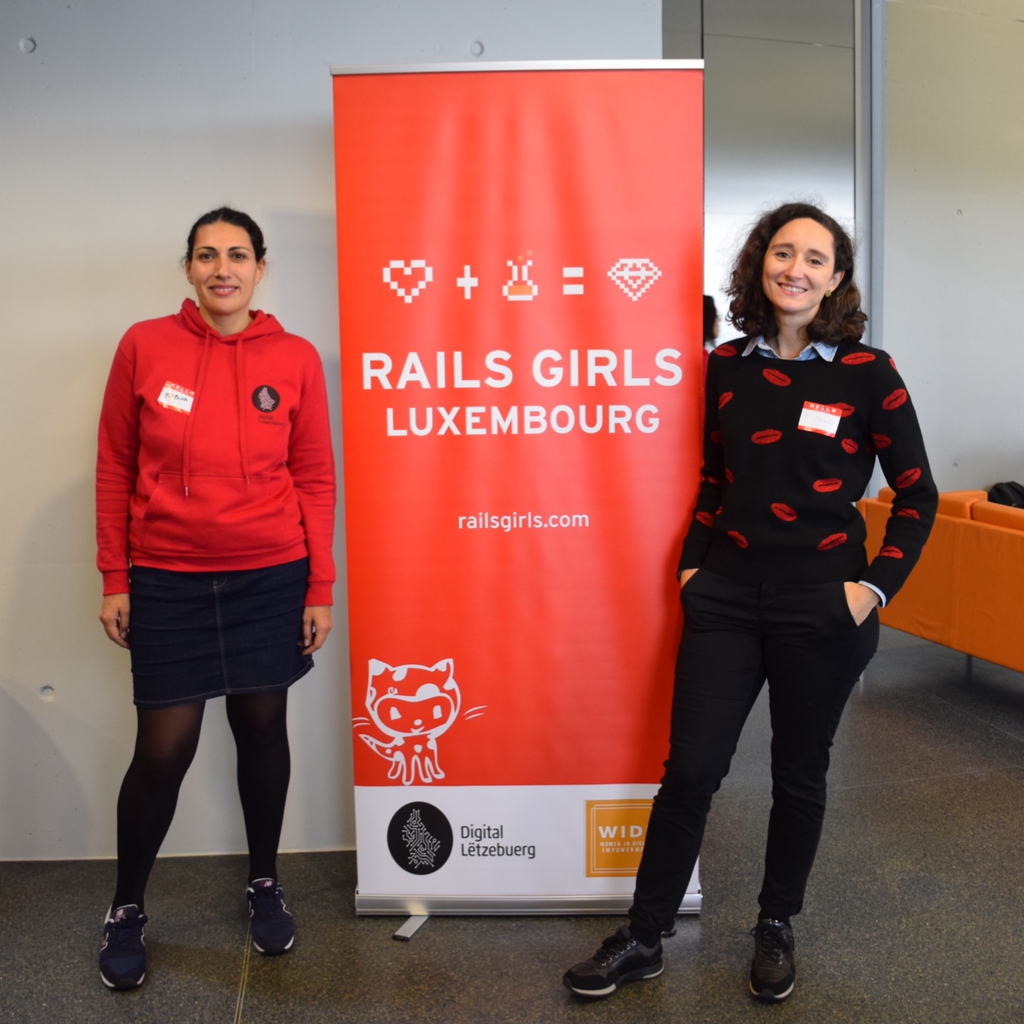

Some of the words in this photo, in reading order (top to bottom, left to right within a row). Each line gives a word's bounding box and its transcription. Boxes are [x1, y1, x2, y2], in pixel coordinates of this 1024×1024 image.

[362, 350, 513, 390] RAILS
[532, 348, 683, 388] GIRLS
[809, 403, 837, 413] HELLO
[386, 404, 660, 436] LUXEMBOURG
[458, 512, 589, 532] railsgirls.com
[460, 824, 504, 842] Digital
[598, 825, 644, 839] WID
[460, 842, 536, 860] Lëtzebuerg
